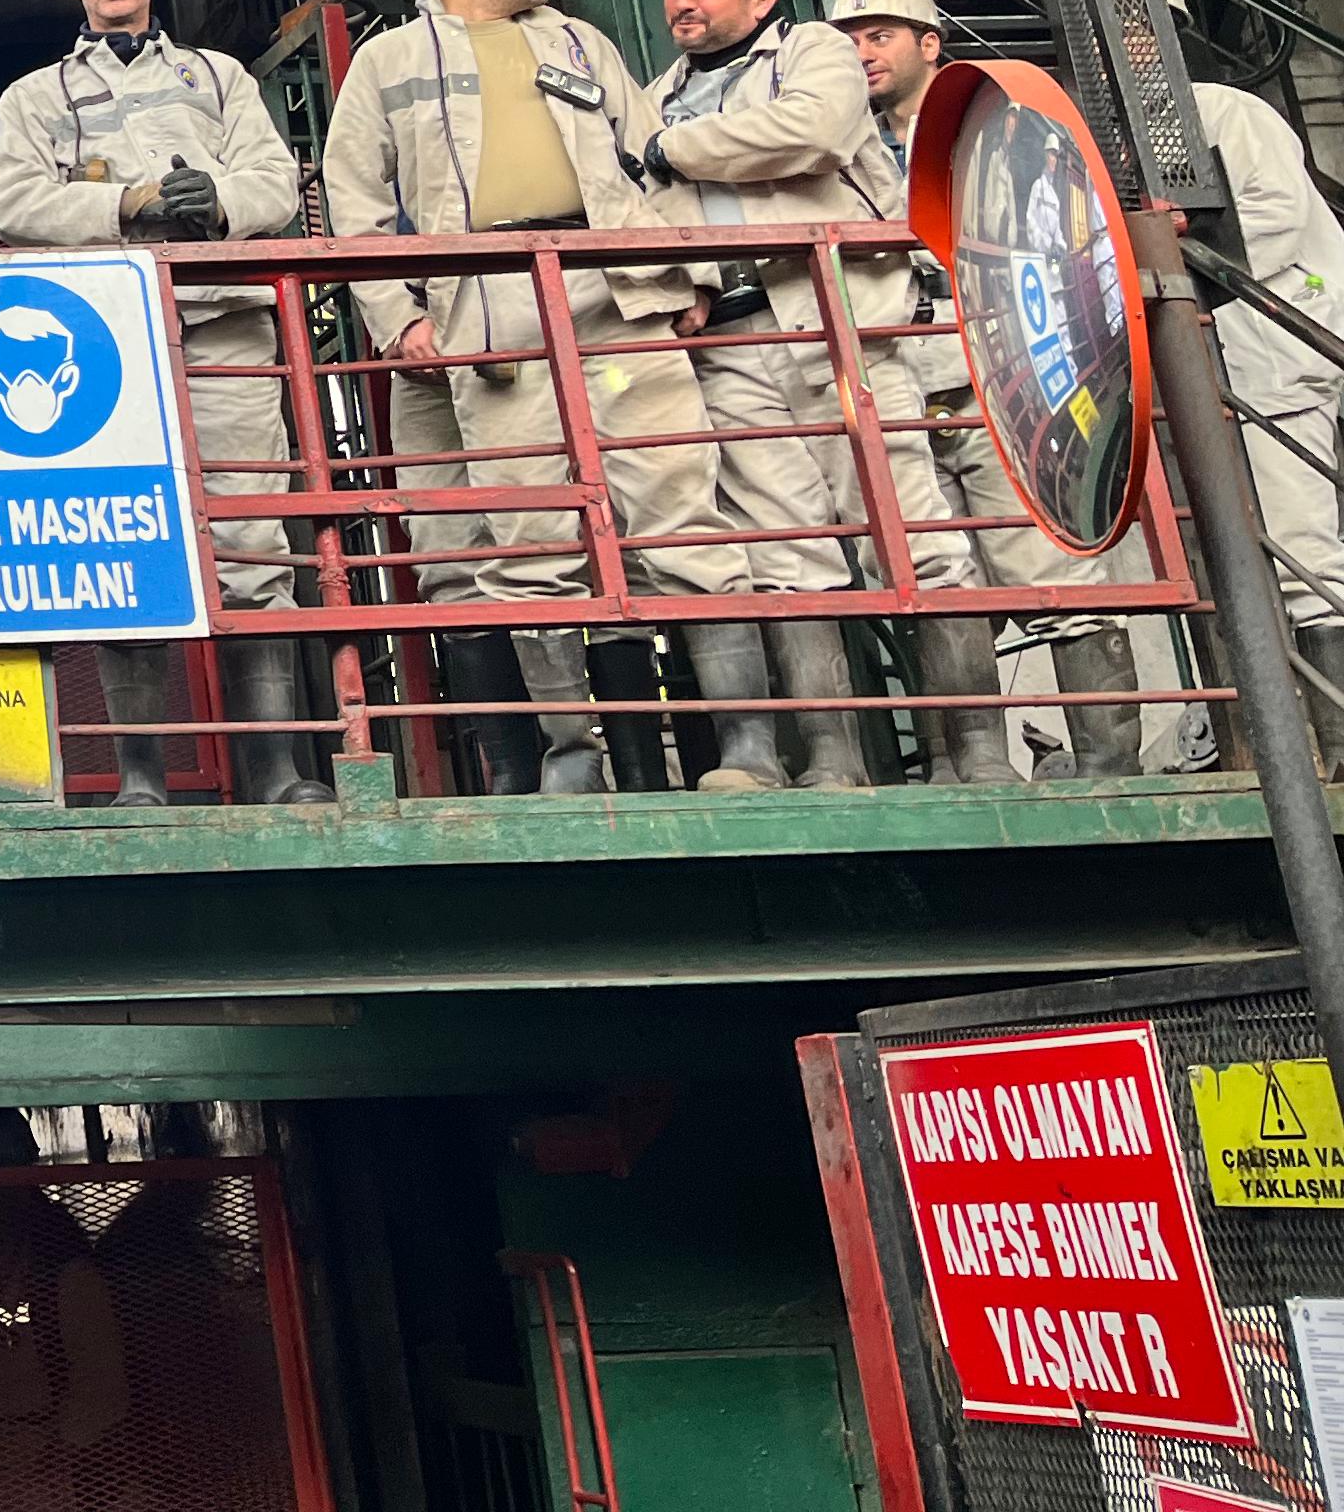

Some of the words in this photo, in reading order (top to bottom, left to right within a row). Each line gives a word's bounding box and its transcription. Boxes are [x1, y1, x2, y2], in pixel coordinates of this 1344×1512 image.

[7, 484, 170, 546] MASKESİ
[901, 1088, 998, 1163] KAPISI
[994, 1076, 1152, 1162] OLMAYAN
[1314, 1147, 1344, 1168] VA
[1239, 1179, 1344, 1205] YAKLAŞM
[932, 1202, 1051, 1278] KAFESE
